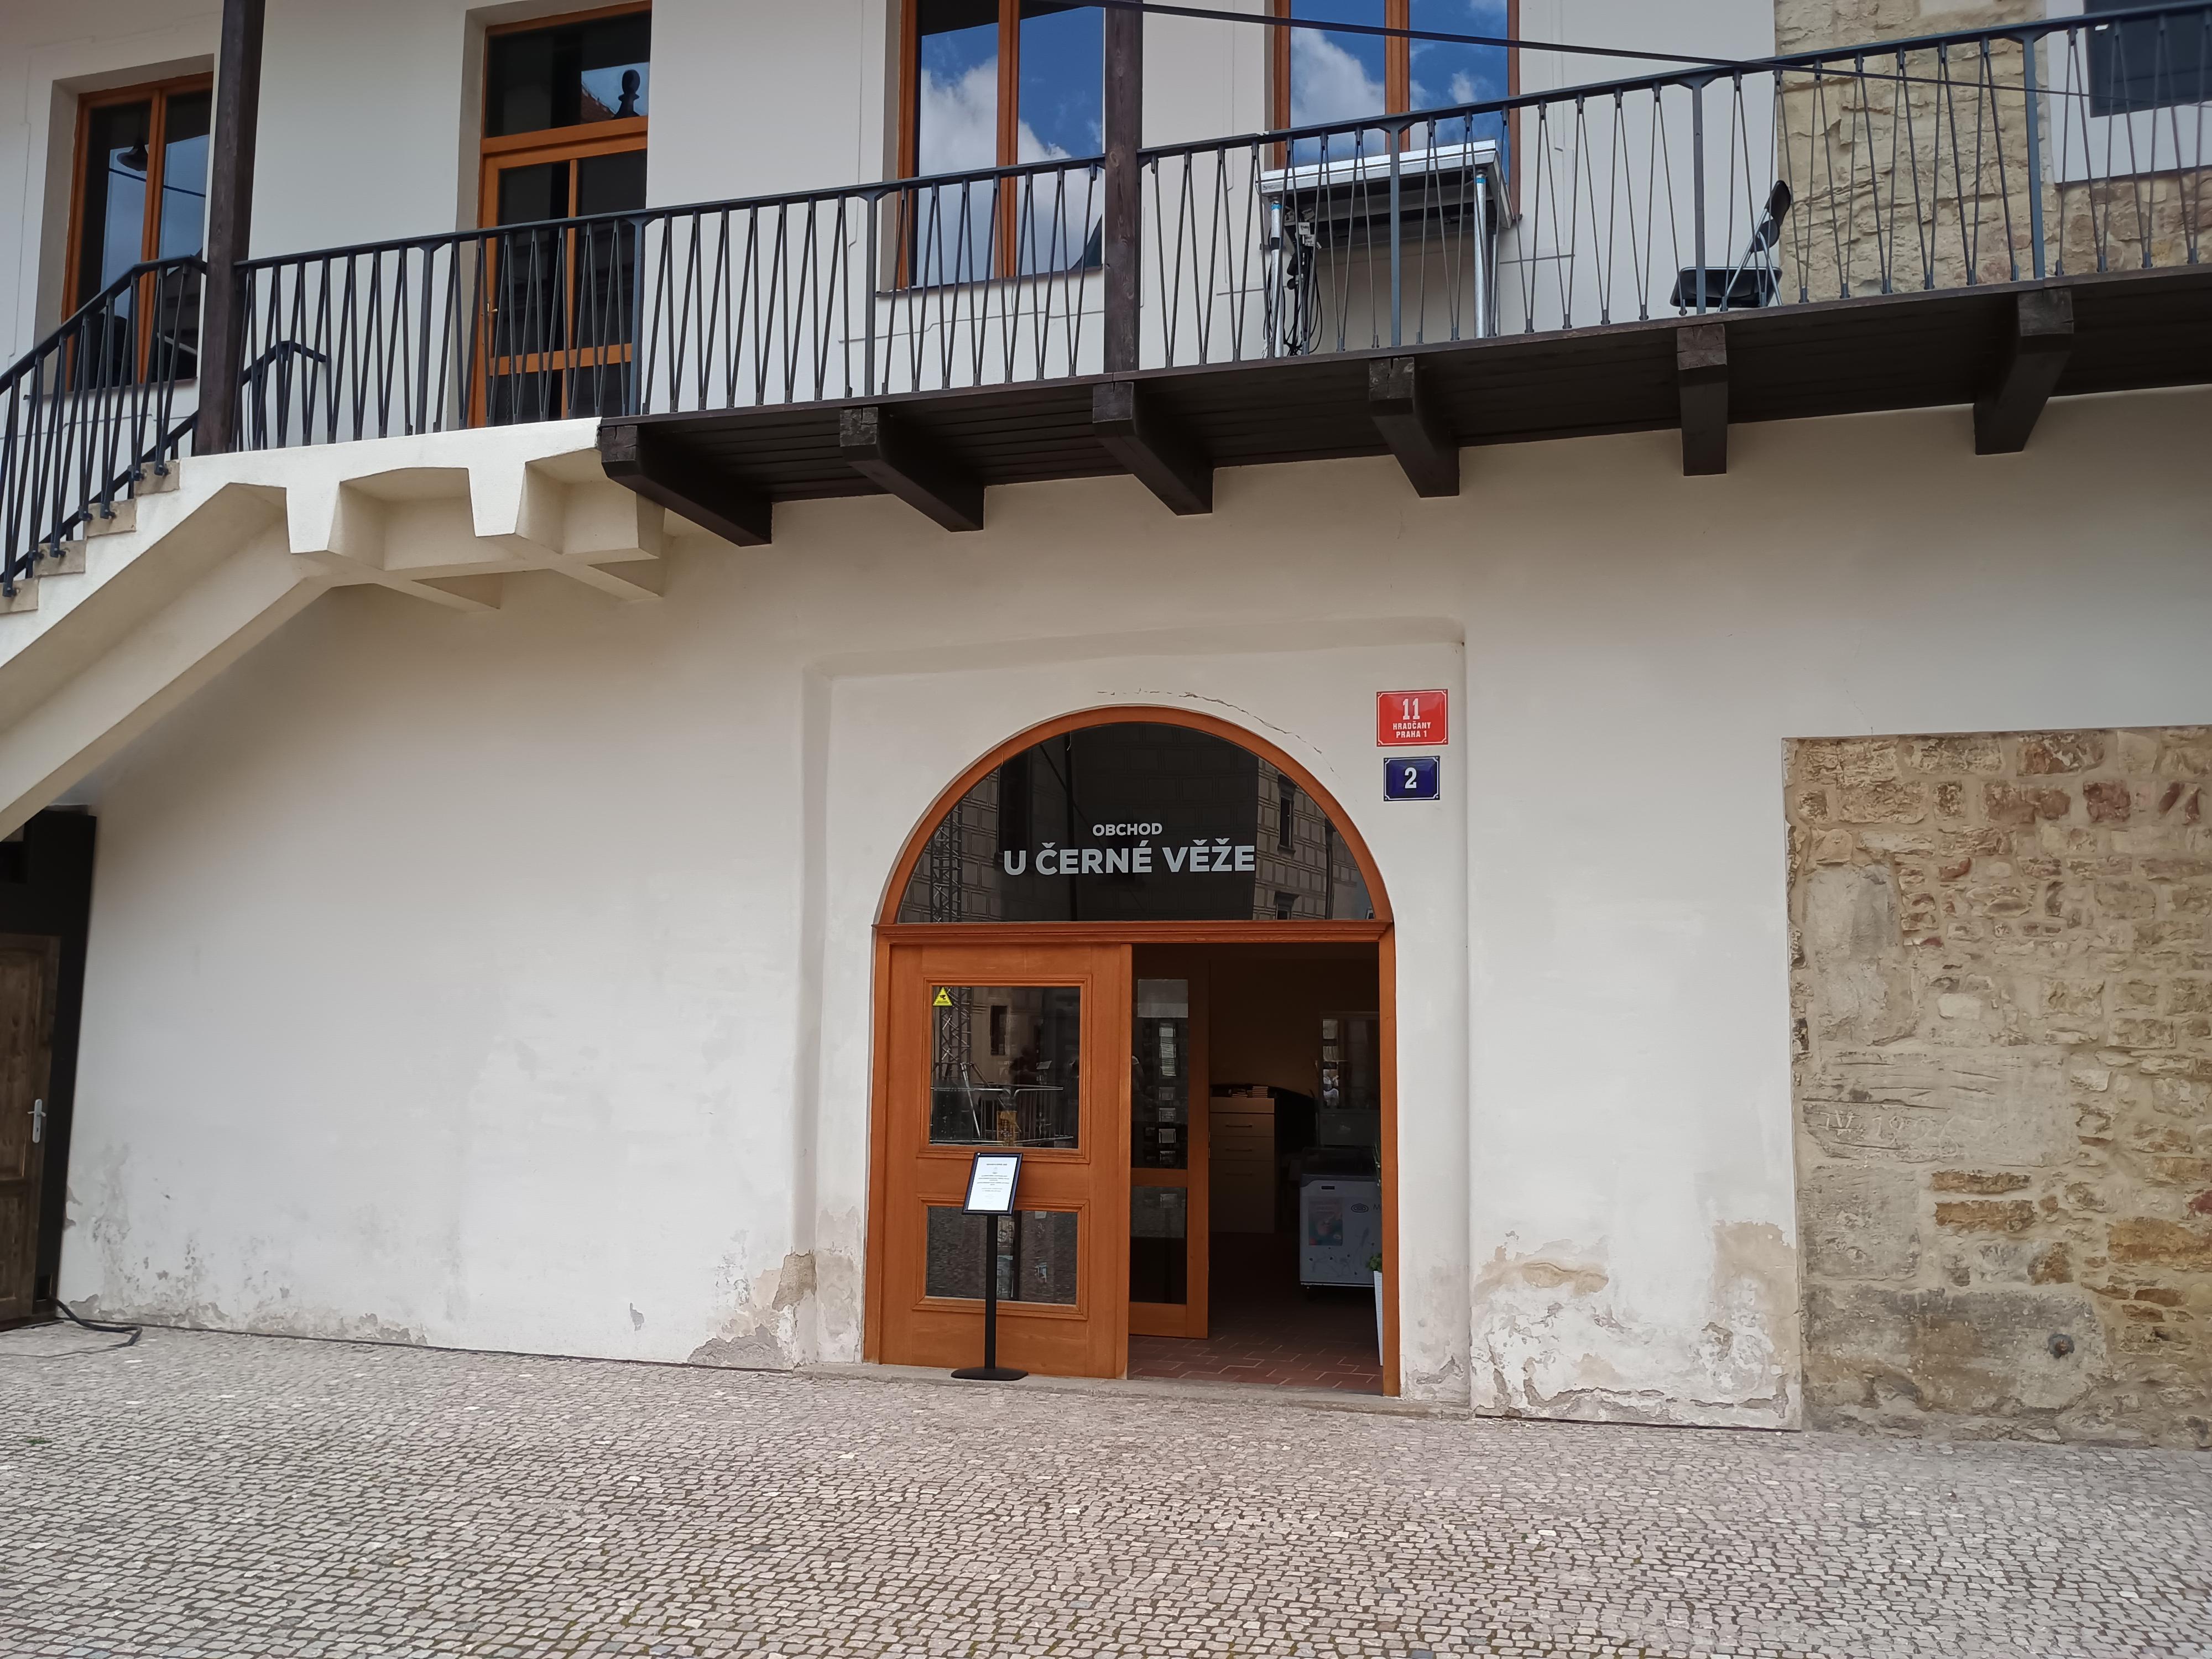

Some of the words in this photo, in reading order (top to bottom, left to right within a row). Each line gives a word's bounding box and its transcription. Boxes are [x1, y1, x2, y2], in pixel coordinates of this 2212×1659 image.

[1402, 698, 1420, 720] 11
[1392, 721, 1431, 730] HRADČANY
[1396, 730, 1421, 738] PRAHA
[1404, 766, 1417, 789] 2
[1093, 823, 1162, 836] OBCHOD
[1004, 849, 1027, 875] U
[1035, 839, 1152, 875] ČERNÉ
[1161, 837, 1255, 873] VĚŽE
